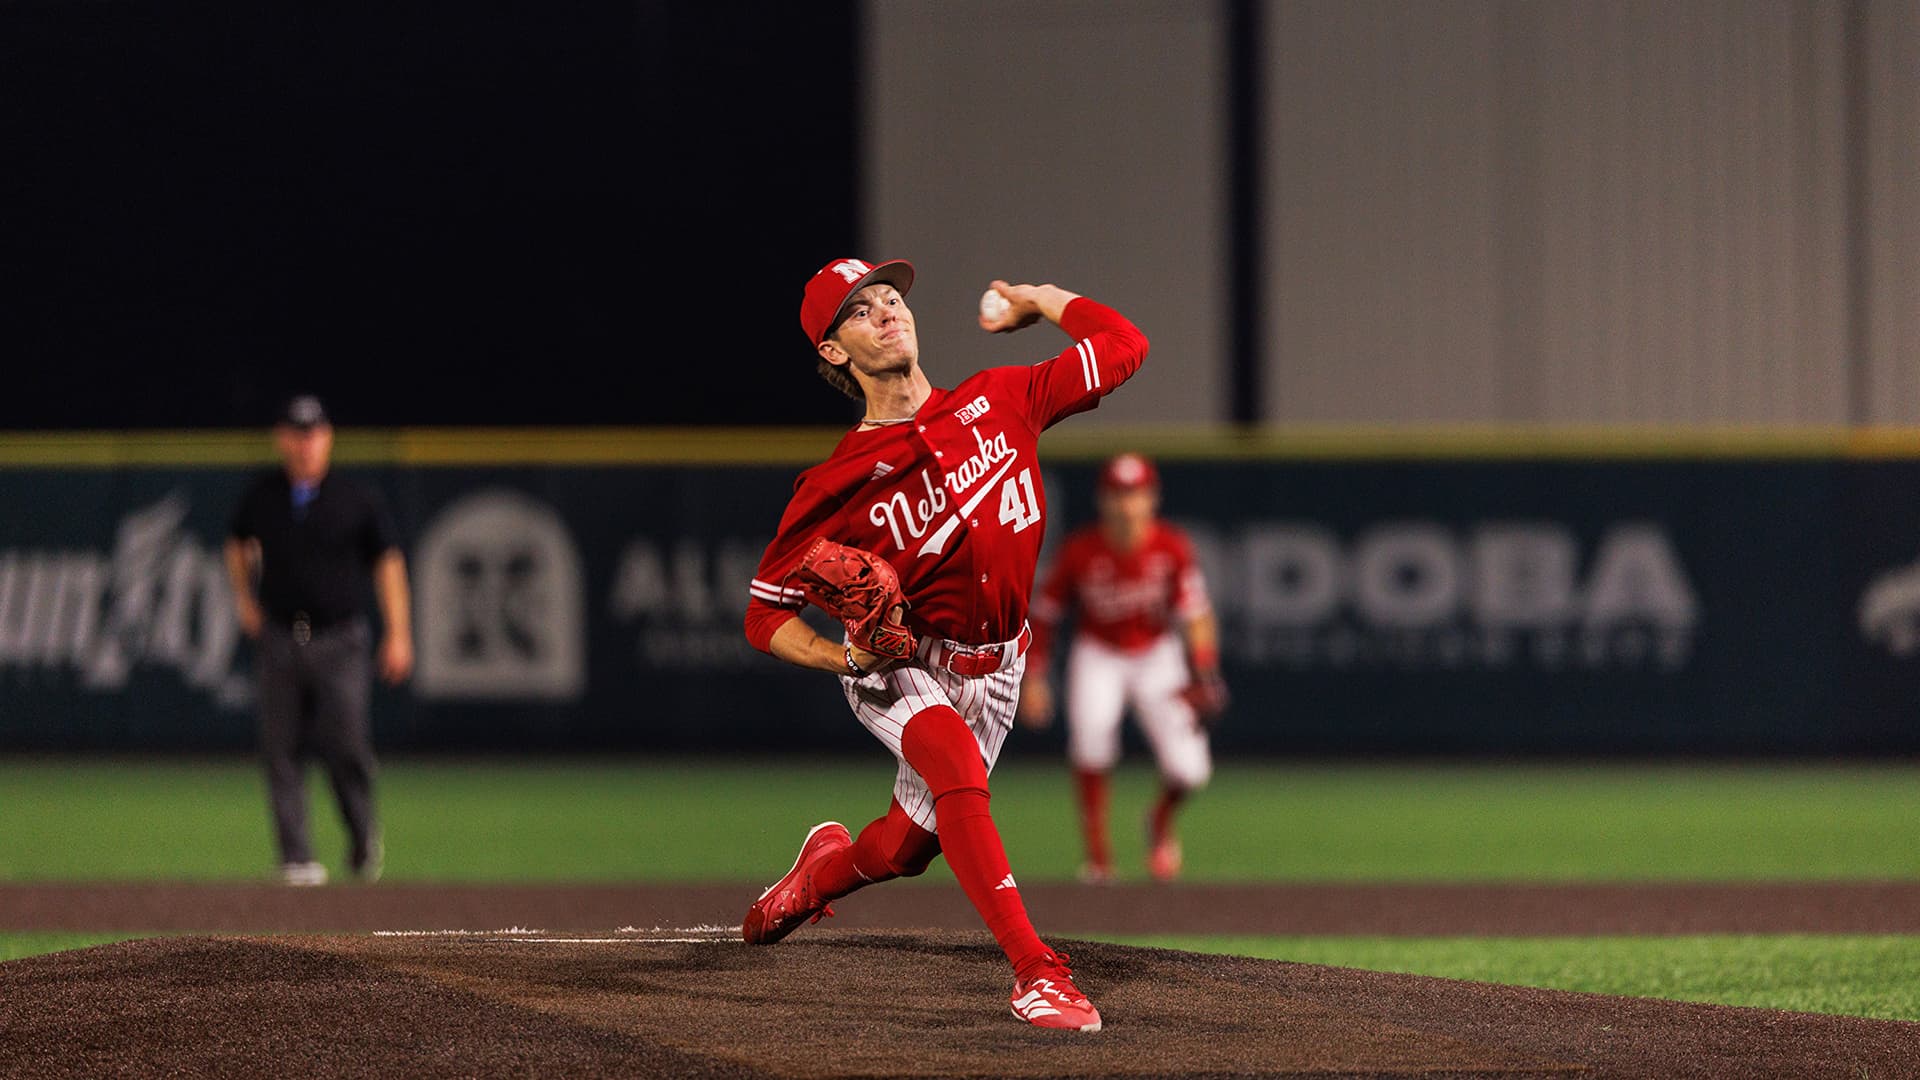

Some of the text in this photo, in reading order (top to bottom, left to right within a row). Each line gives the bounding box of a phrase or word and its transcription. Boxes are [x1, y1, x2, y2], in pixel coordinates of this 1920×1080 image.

[831, 259, 871, 284] N
[869, 425, 1018, 551] Nebraska
[998, 467, 1041, 534] 41
[1178, 522, 1697, 628] DOBA
